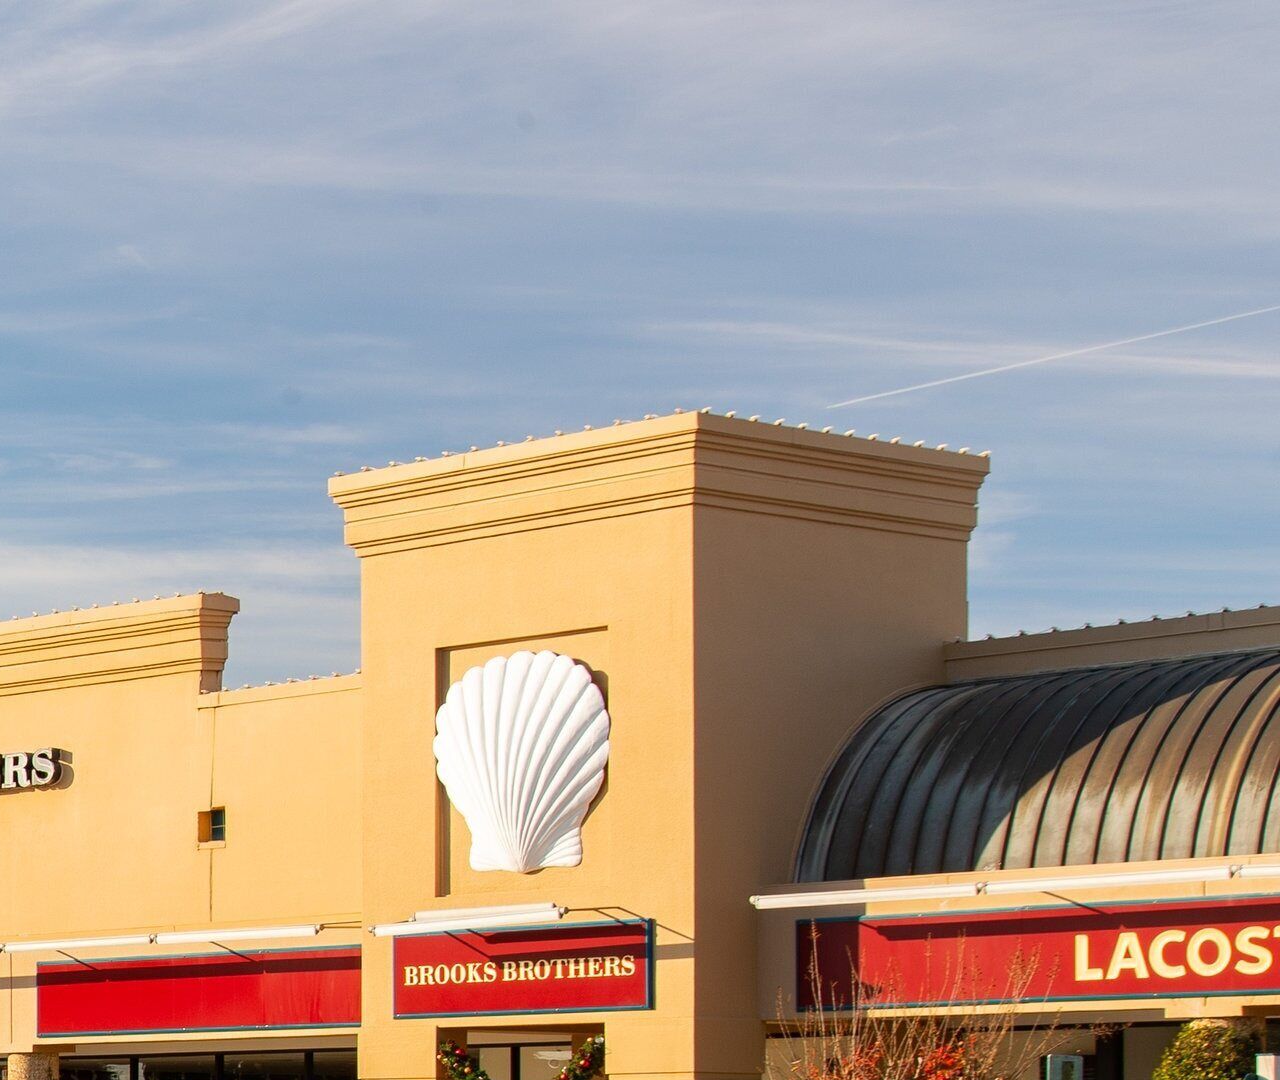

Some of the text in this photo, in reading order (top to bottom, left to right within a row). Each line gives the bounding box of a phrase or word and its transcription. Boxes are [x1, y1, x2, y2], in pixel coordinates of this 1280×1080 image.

[403, 955, 636, 986] BROOKS BROTHERS
[1074, 925, 1280, 981] LACOS
